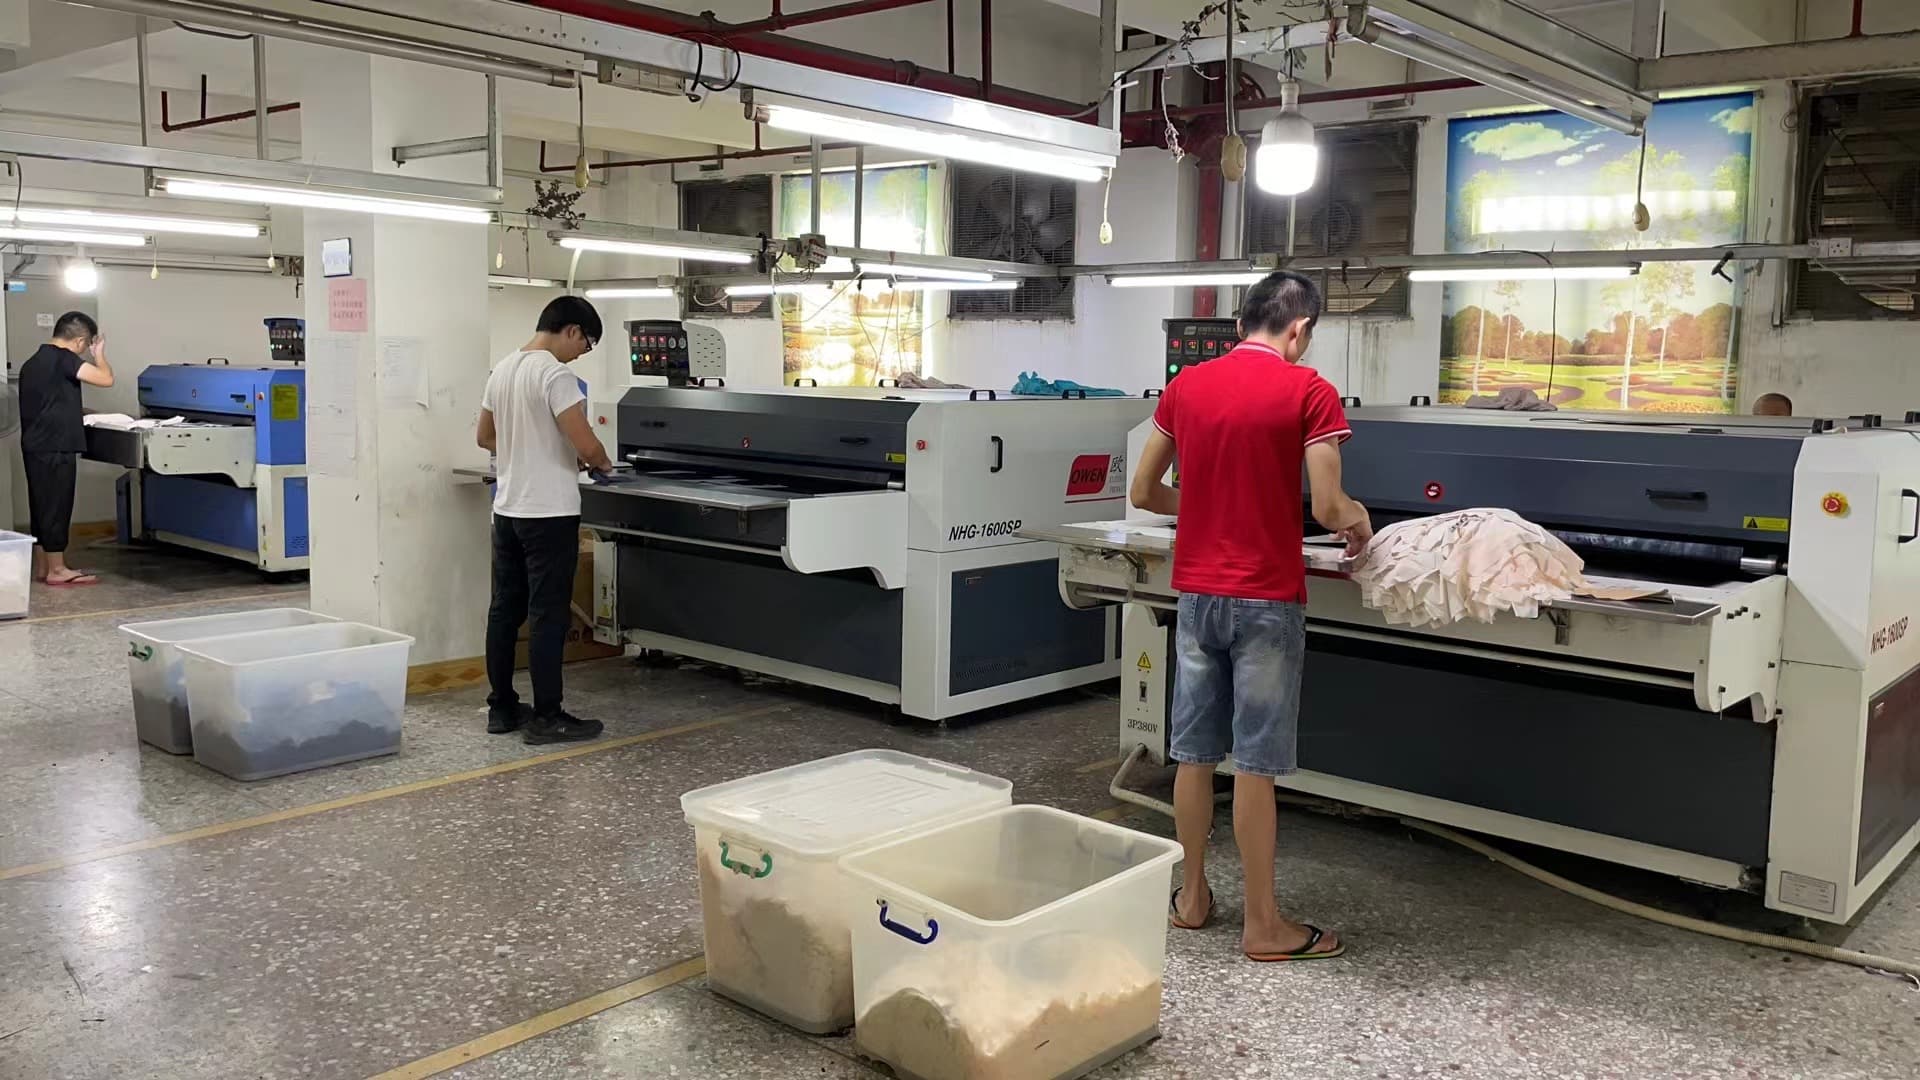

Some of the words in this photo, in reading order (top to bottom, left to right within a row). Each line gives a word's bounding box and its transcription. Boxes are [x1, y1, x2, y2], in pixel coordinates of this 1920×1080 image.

[1071, 467, 1106, 485] OWEN
[948, 519, 1022, 541] NHG-1600SP
[1127, 718, 1158, 733] 3P380V
